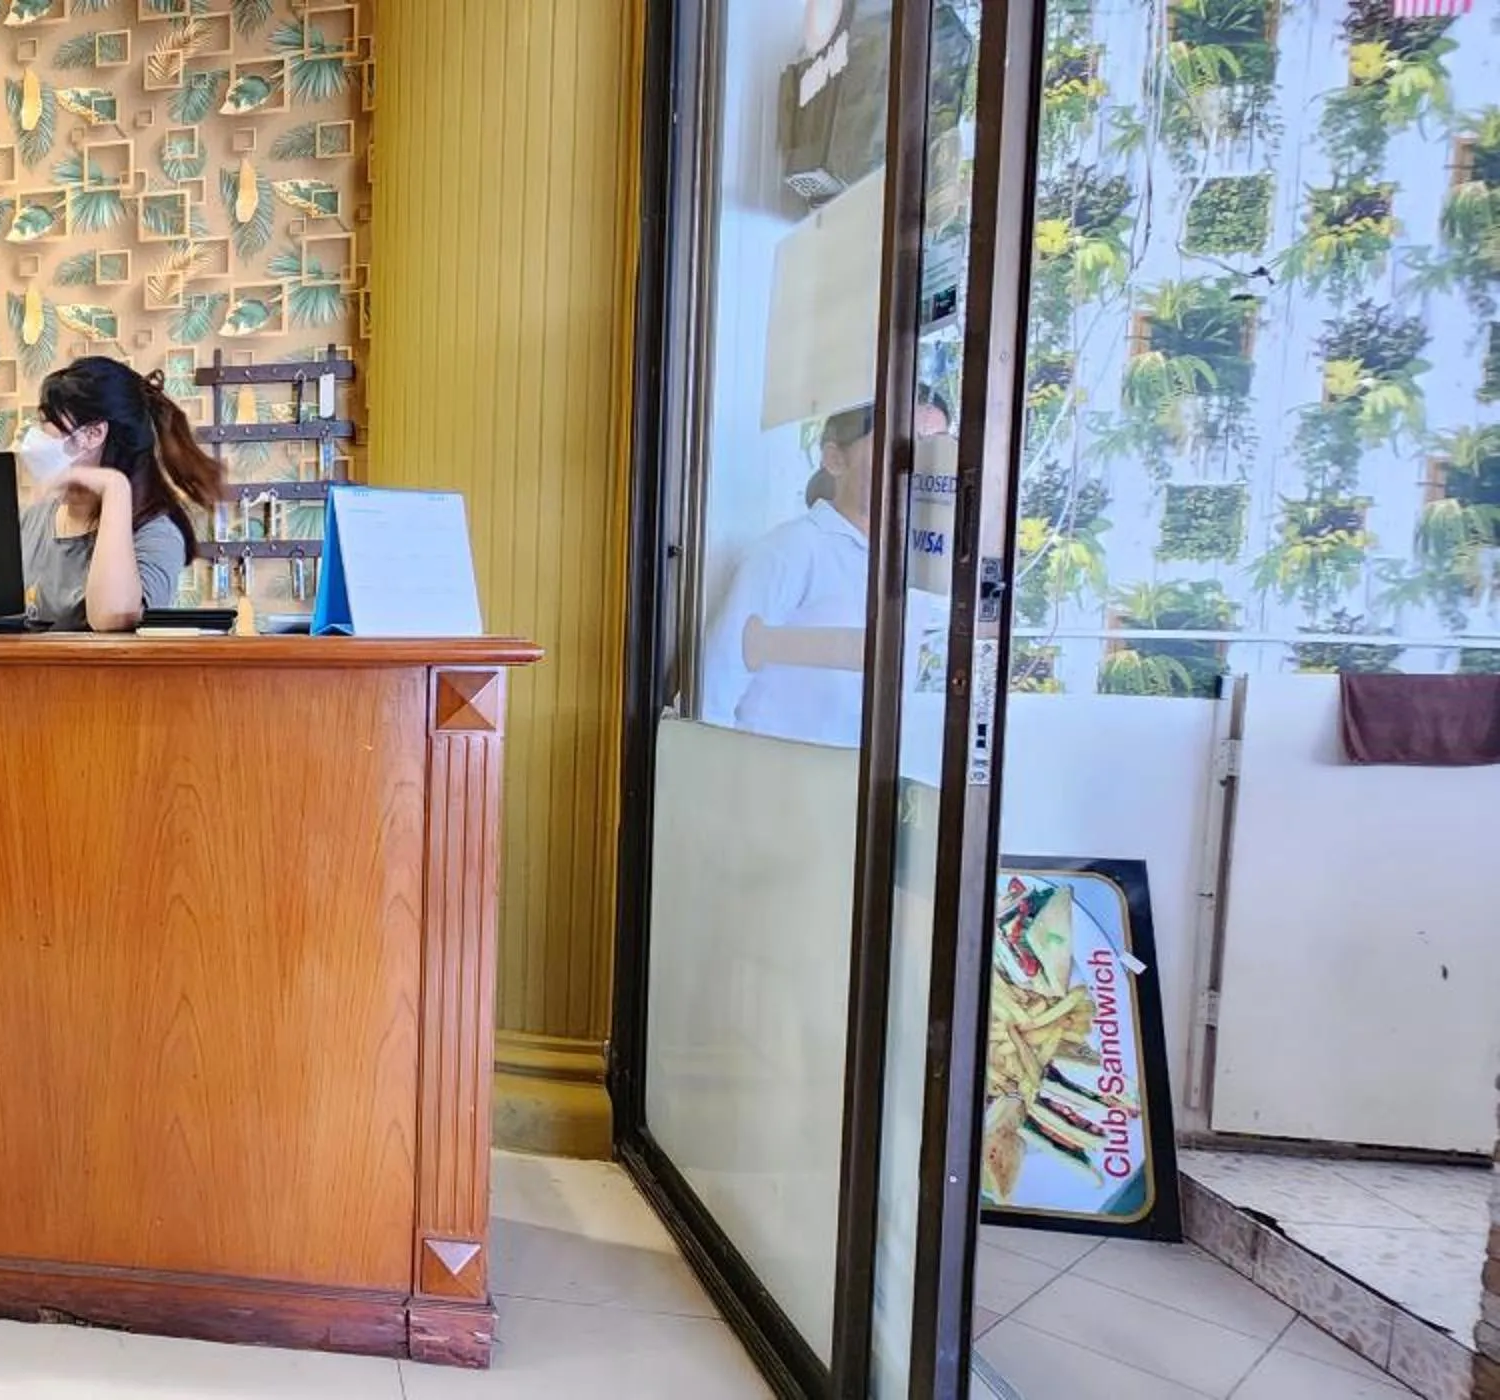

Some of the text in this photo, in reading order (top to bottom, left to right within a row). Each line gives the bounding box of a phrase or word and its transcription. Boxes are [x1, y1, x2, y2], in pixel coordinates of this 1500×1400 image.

[911, 528, 945, 556] VISA
[1086, 948, 1131, 1179] Club Sandwich
